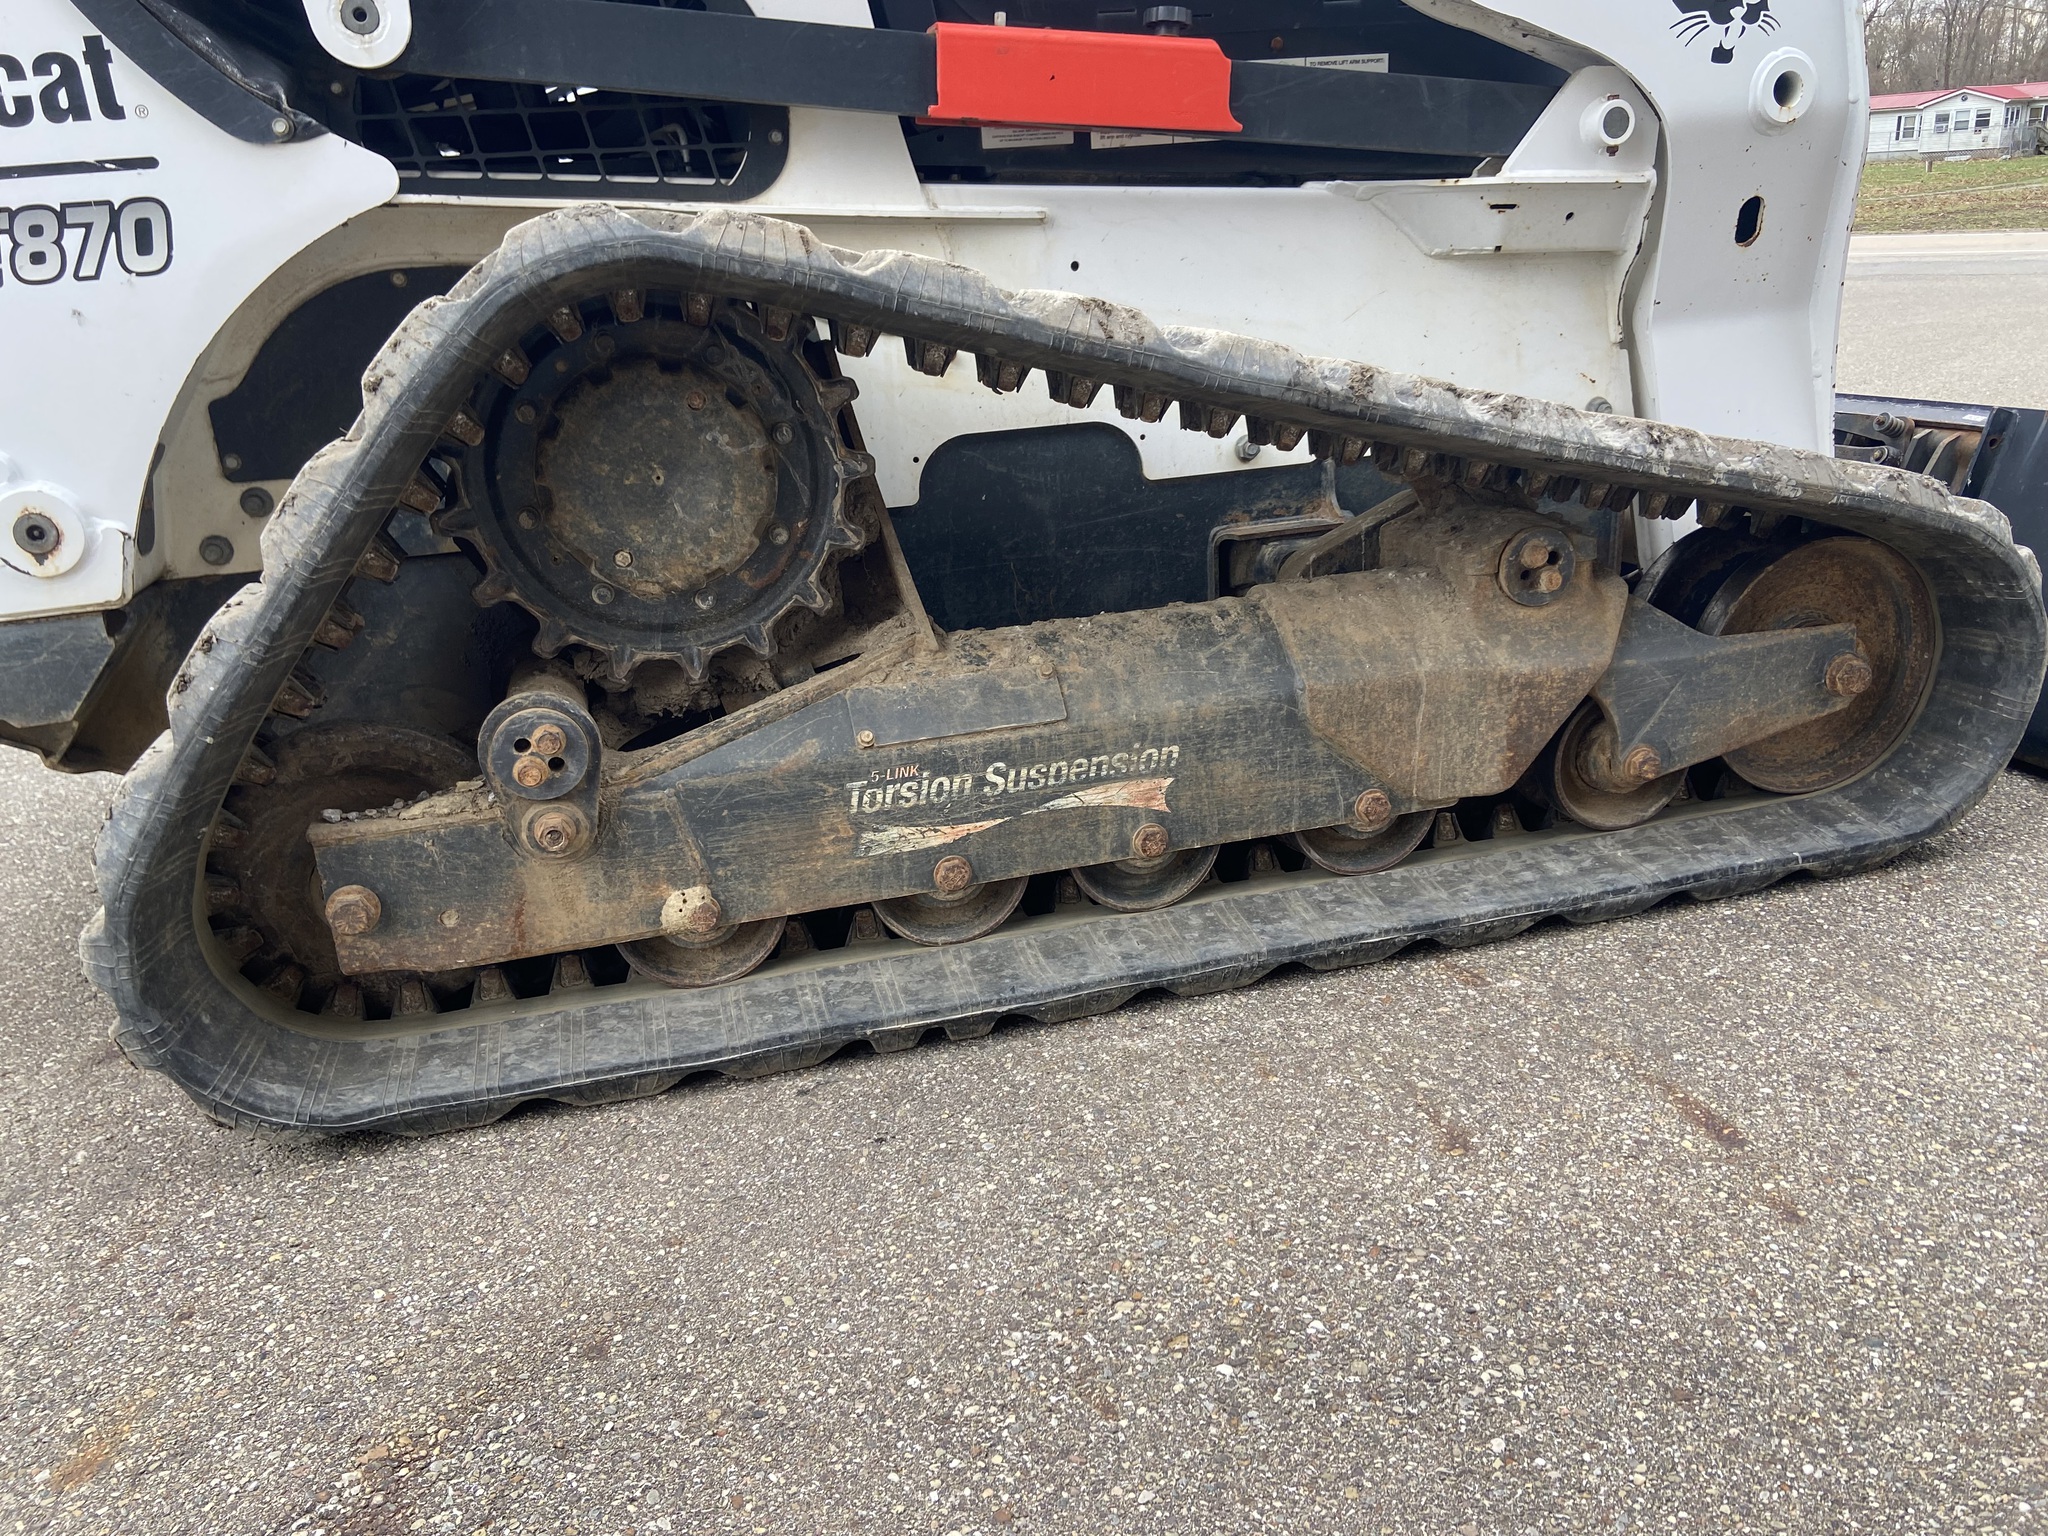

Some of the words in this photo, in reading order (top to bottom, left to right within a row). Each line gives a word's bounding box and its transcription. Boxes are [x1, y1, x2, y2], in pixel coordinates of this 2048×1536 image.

[845, 771, 972, 815] Torsion
[983, 743, 1180, 797] Suspension
[871, 764, 920, 783] 5-LINK
